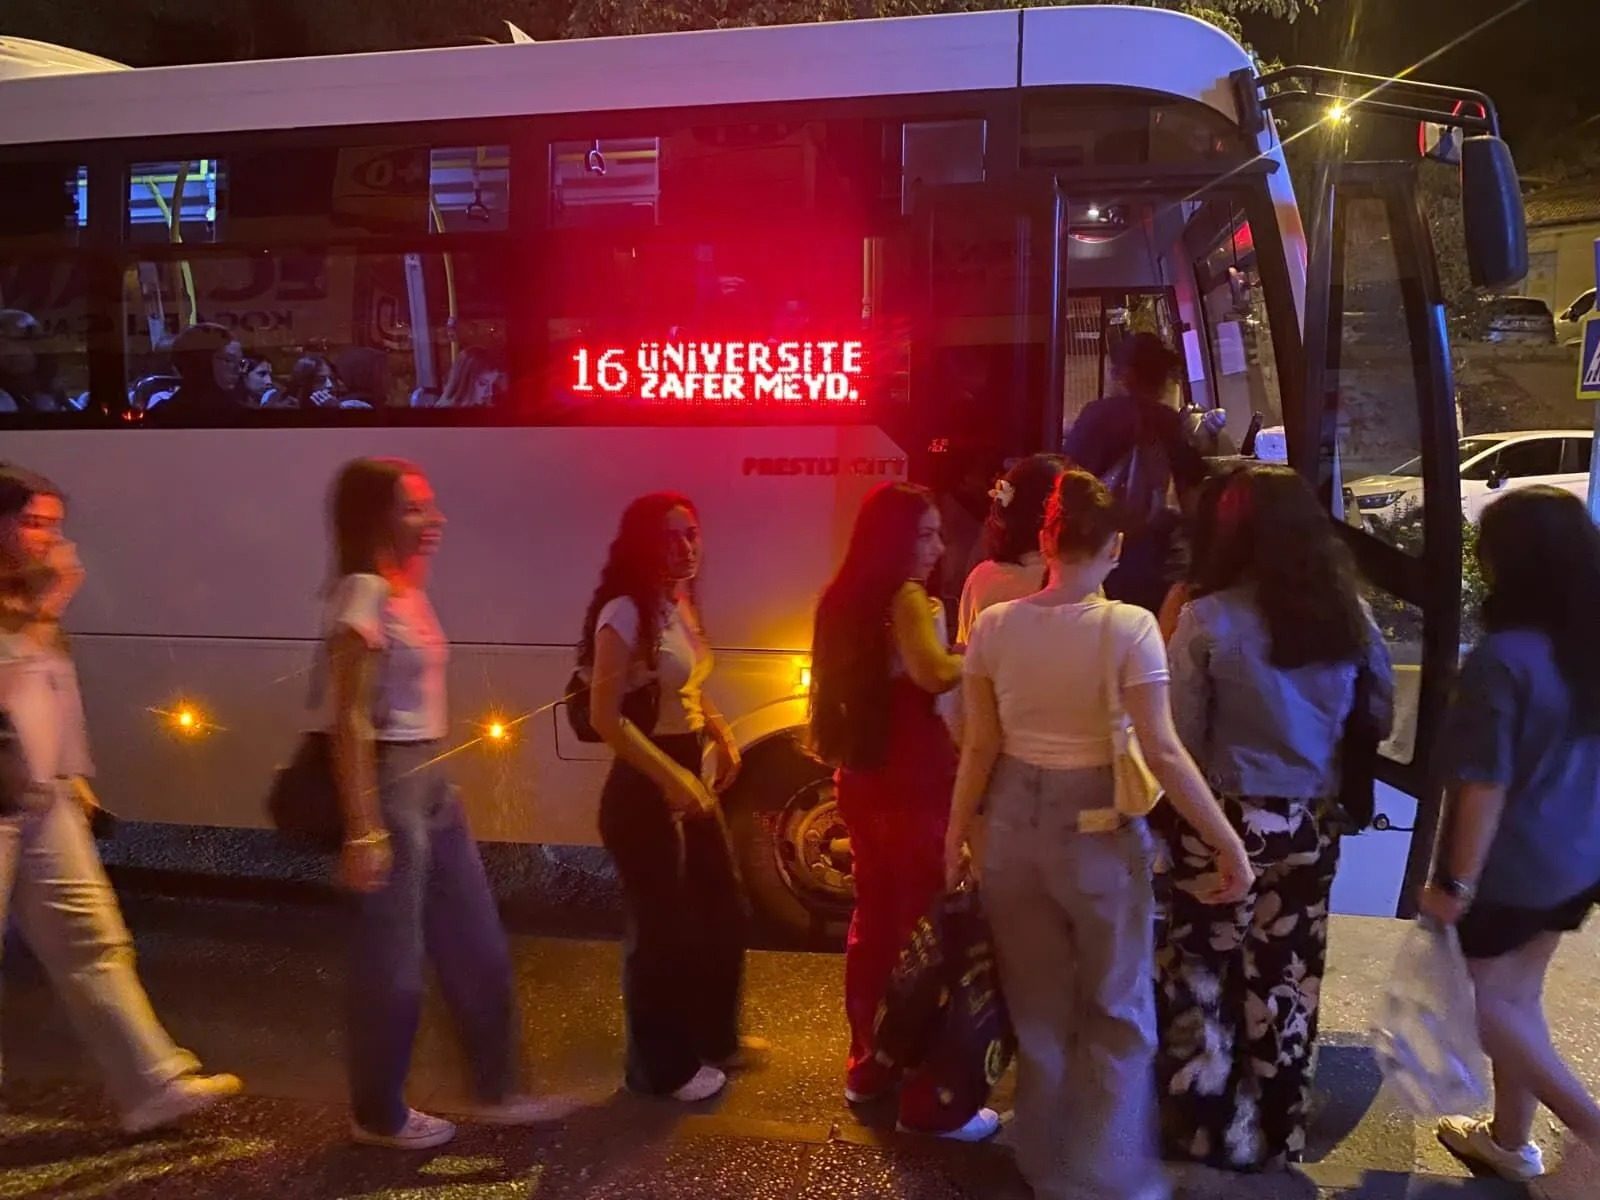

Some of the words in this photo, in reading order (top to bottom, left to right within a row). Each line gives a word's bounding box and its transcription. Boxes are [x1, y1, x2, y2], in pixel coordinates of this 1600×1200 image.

[572, 348, 628, 392] 16
[640, 373, 745, 399] ZAFER
[753, 373, 860, 400] MEYD.
